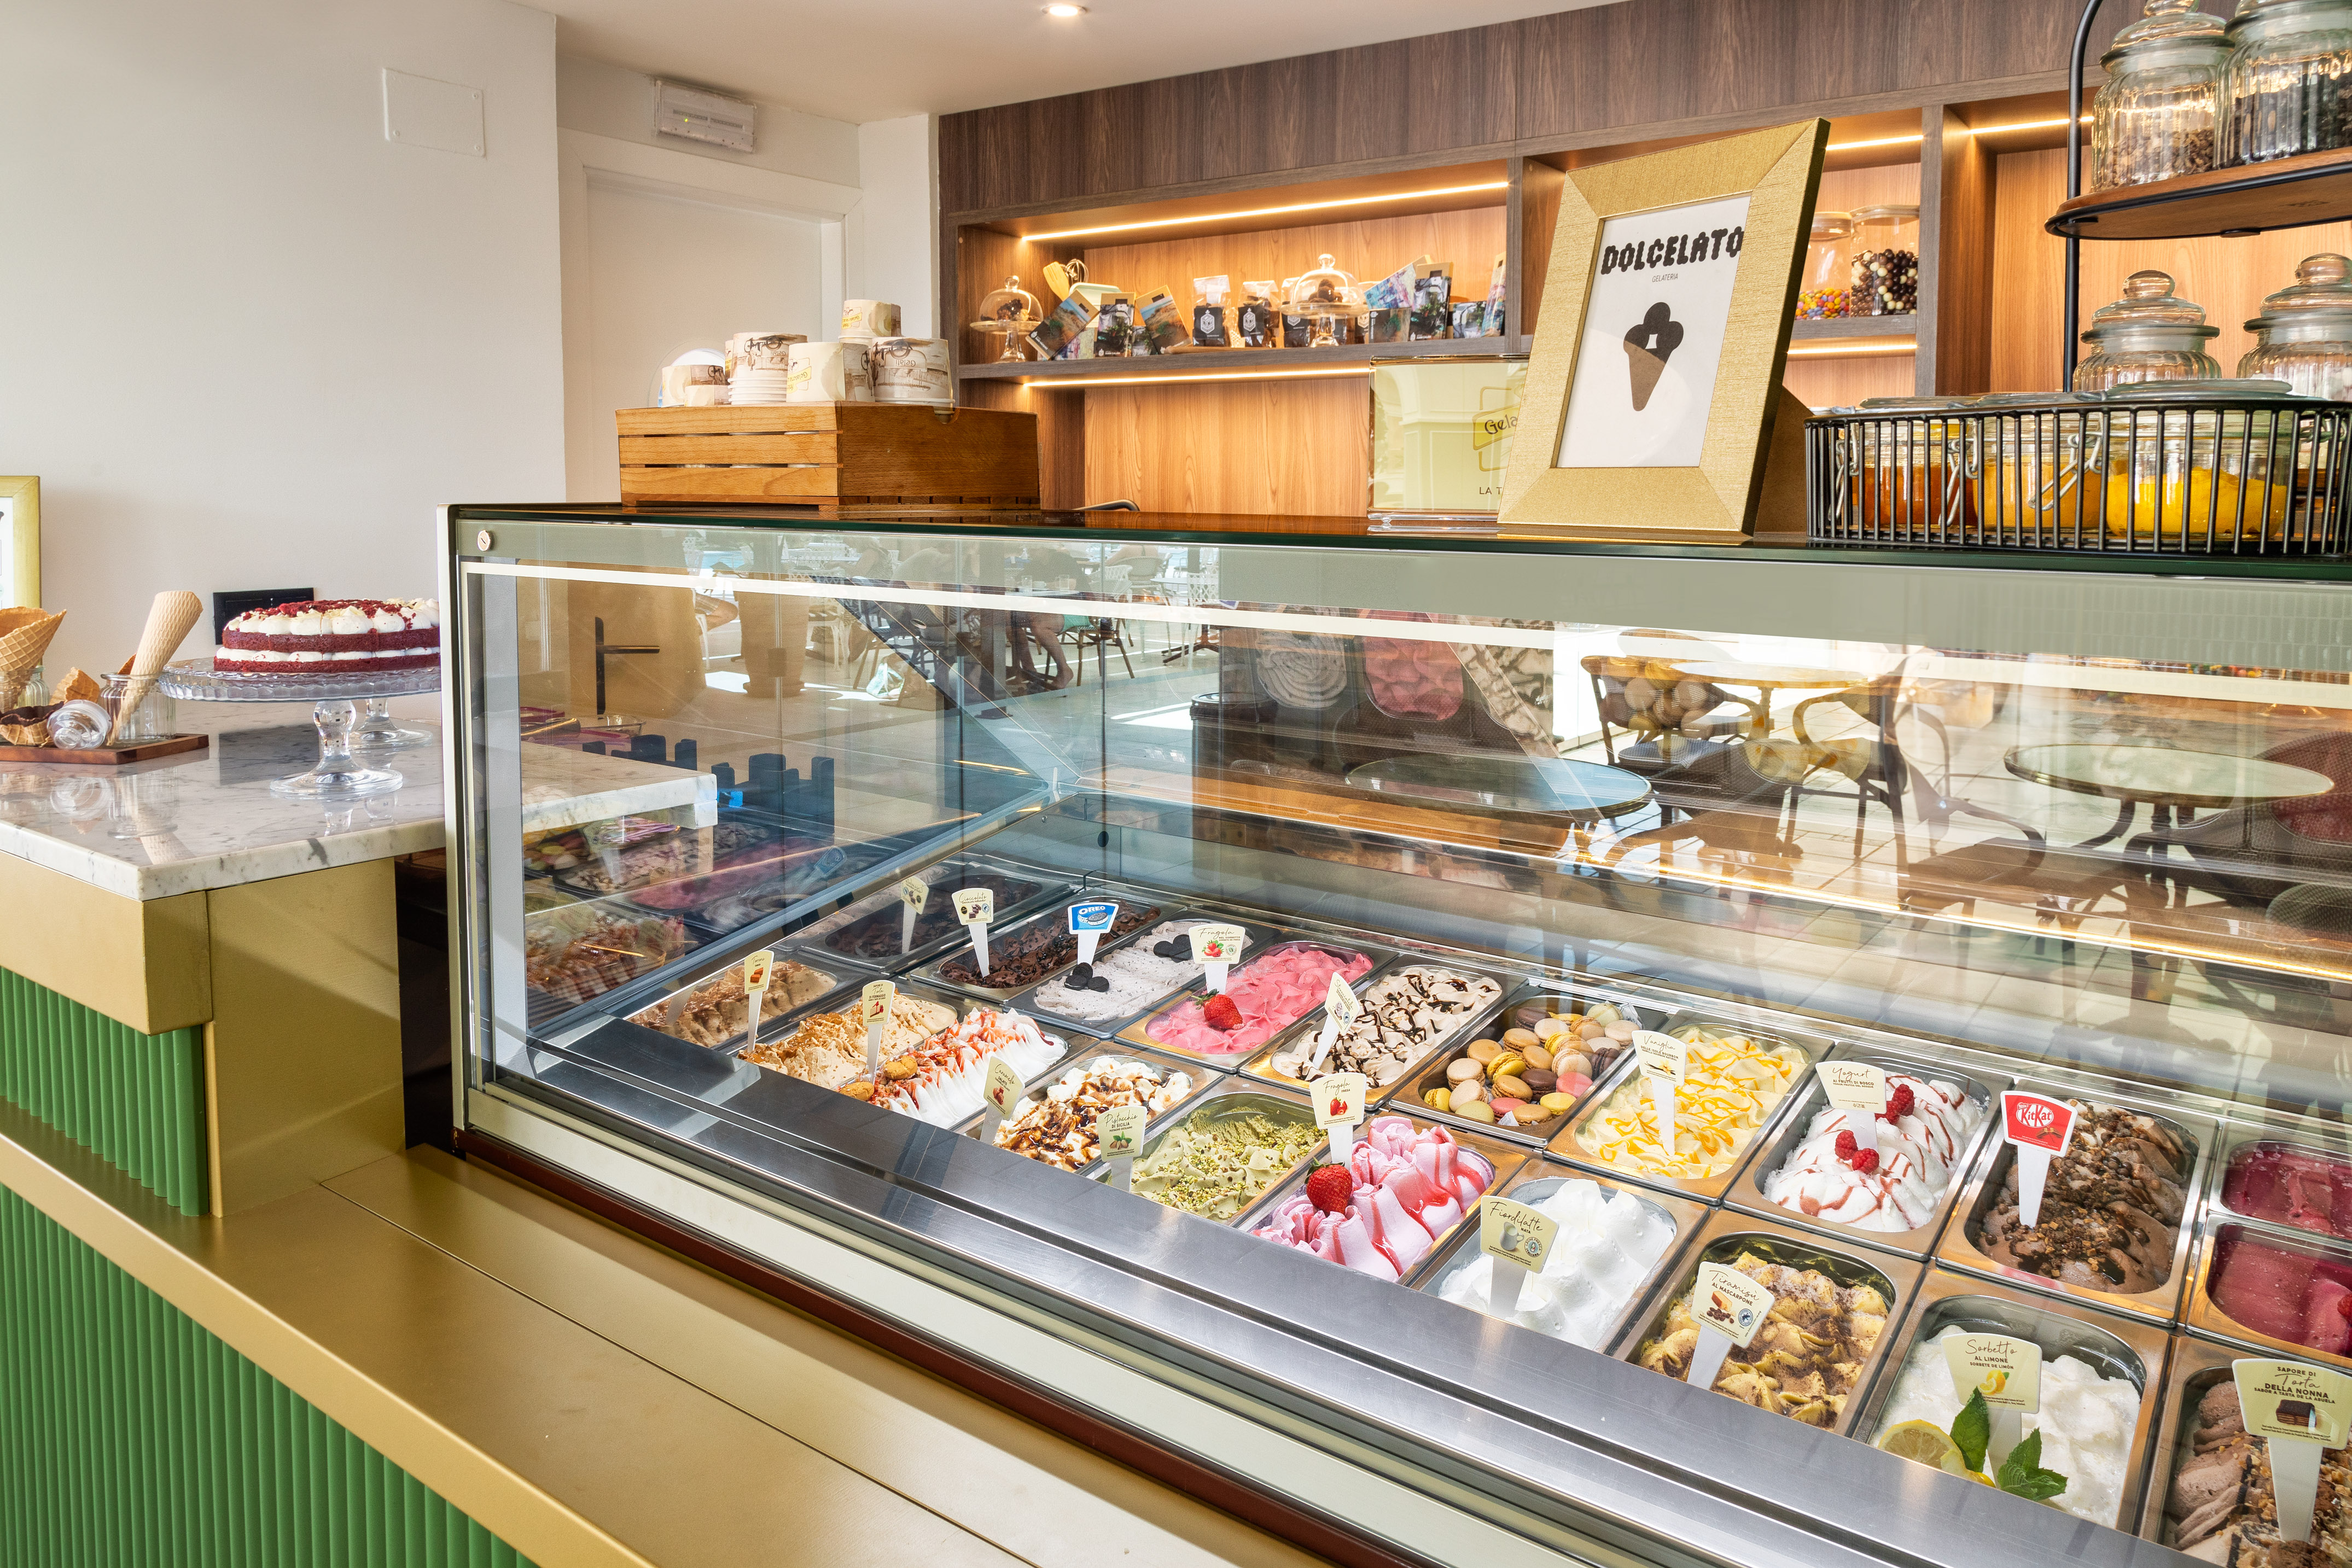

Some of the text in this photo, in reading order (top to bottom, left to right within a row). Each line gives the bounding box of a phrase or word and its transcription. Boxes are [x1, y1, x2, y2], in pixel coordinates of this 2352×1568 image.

[1600, 226, 1744, 275] DOLCELATO
[1652, 273, 1678, 282] GELATERIA
[1479, 487, 1492, 495] LA
[959, 892, 987, 902] Cioccolato
[1078, 906, 1105, 915] OREO
[1197, 928, 1234, 940] Fragola
[872, 987, 884, 995] Torta
[1644, 1035, 1675, 1052] Vaniglia
[998, 1076, 1008, 1086] SALATO
[1832, 1068, 1871, 1081] Yogurt
[1323, 1078, 1350, 1095] Fragola
[1104, 1110, 1138, 1127] Pistacchio
[2021, 1104, 2052, 1127] KitKat
[1489, 1202, 1543, 1231] Fiordilatte
[1526, 1248, 1539, 1257] ITALIANA
[1709, 1270, 1760, 1301] Tiramisù
[1719, 1286, 1753, 1306] MASCARPONE
[1965, 1339, 2017, 1358] Sorbetto
[2277, 1366, 2306, 1375] SAPORE
[2274, 1373, 2320, 1389] Torta
[2264, 1383, 2329, 1399] DELLA NONNA
